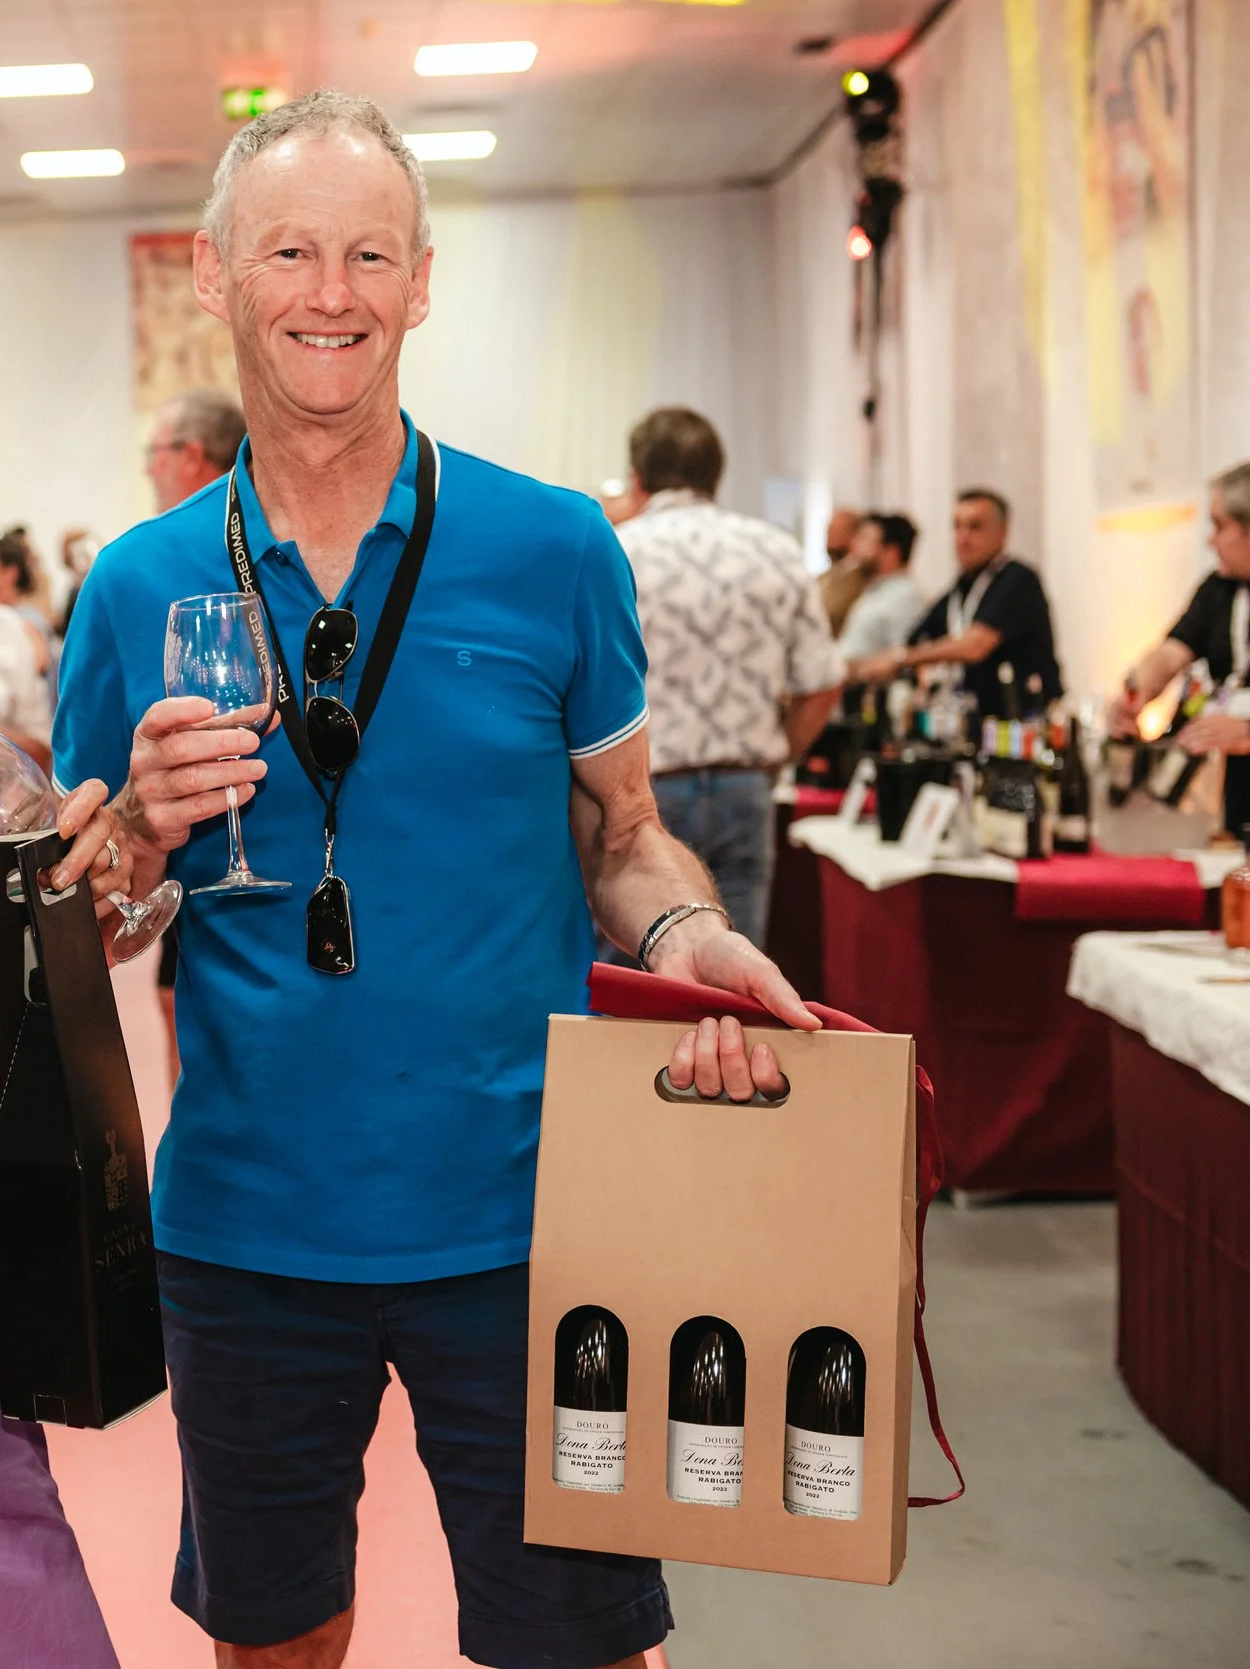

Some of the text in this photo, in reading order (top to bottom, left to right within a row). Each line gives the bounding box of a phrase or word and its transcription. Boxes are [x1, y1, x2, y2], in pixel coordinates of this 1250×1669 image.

[230, 512, 256, 595] PREDIMED
[576, 1421, 609, 1430] DOURO
[704, 1436, 738, 1445] DOURO
[800, 1440, 831, 1452] DOURO
[558, 1450, 593, 1460] RESERVA
[570, 1460, 613, 1469] RABIGATO
[684, 1467, 721, 1476] RESERVA
[698, 1476, 742, 1484] RABIGATO
[787, 1470, 851, 1487] RESERVA BRANCO
[795, 1480, 835, 1493] RABIGATO
[805, 1491, 820, 1499] 2022
